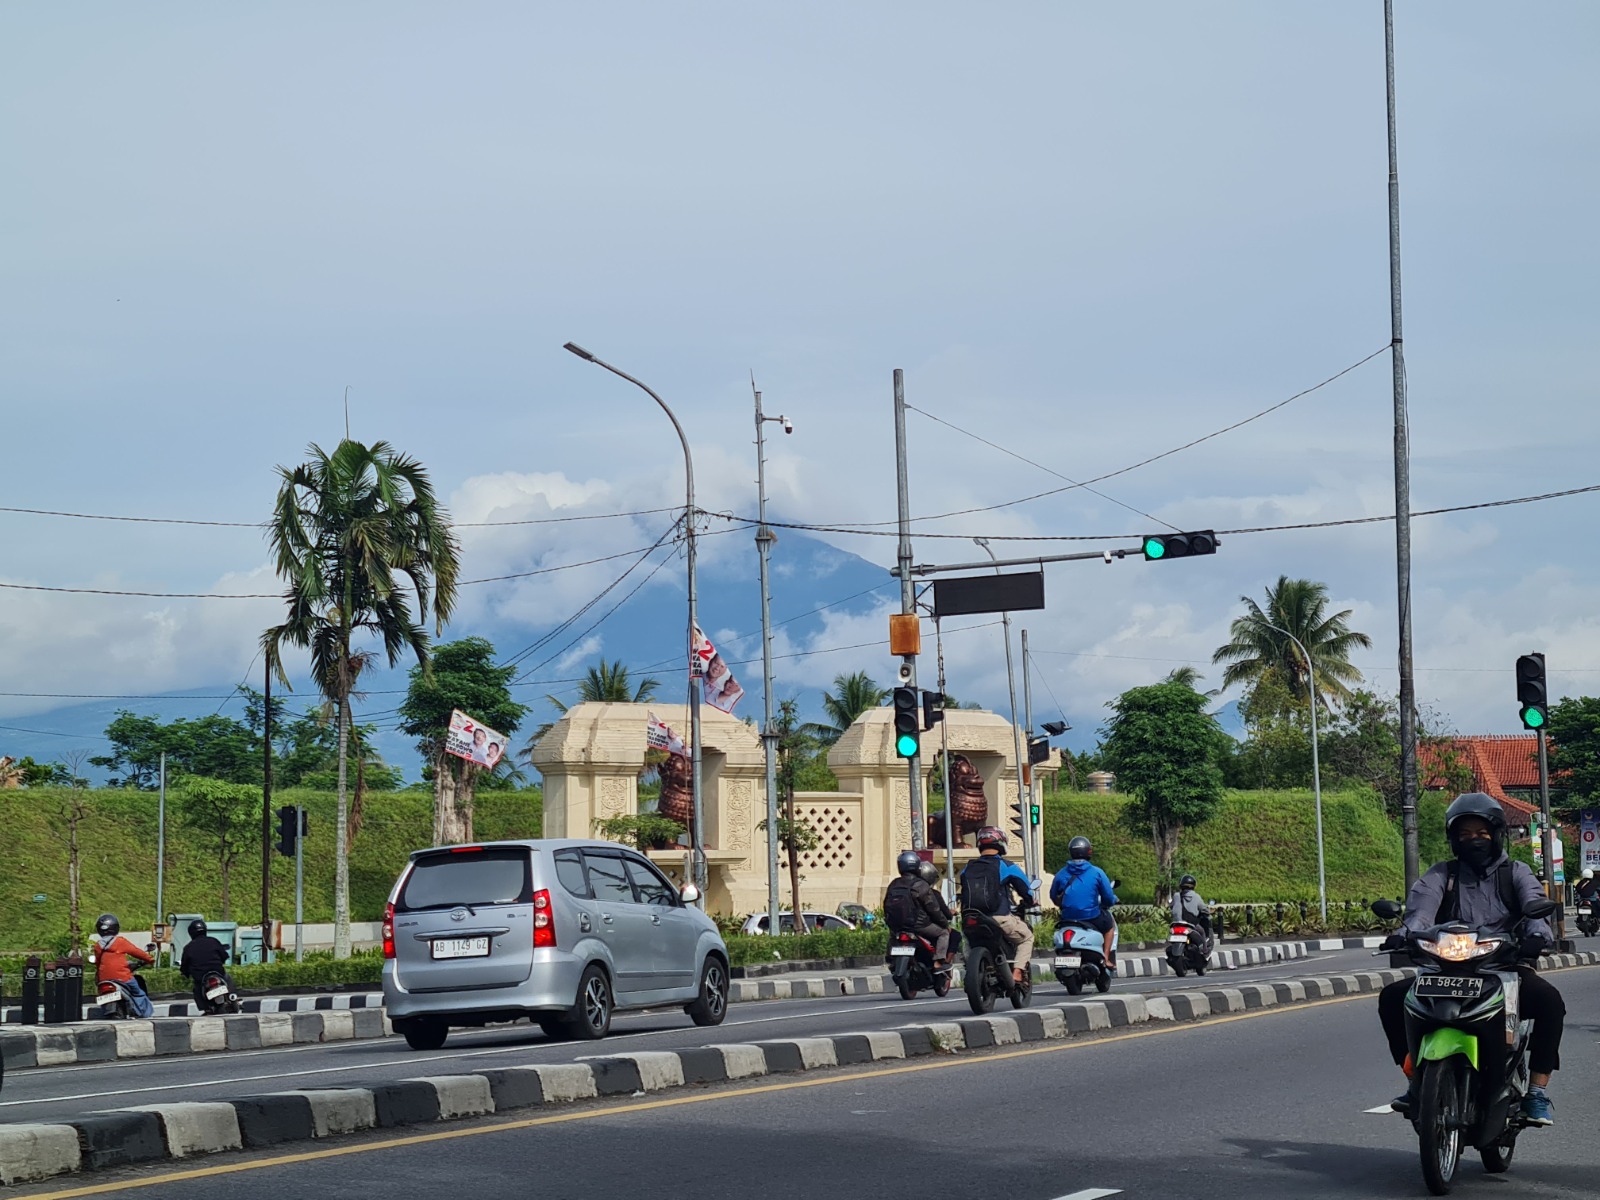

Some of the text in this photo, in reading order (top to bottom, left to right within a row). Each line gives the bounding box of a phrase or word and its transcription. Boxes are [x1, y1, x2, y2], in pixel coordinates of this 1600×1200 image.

[697, 640, 714, 661] 2
[463, 720, 474, 734] 2
[435, 941, 445, 952] AB
[476, 939, 487, 950] GZ
[1418, 977, 1481, 988] AA 5842 FN
